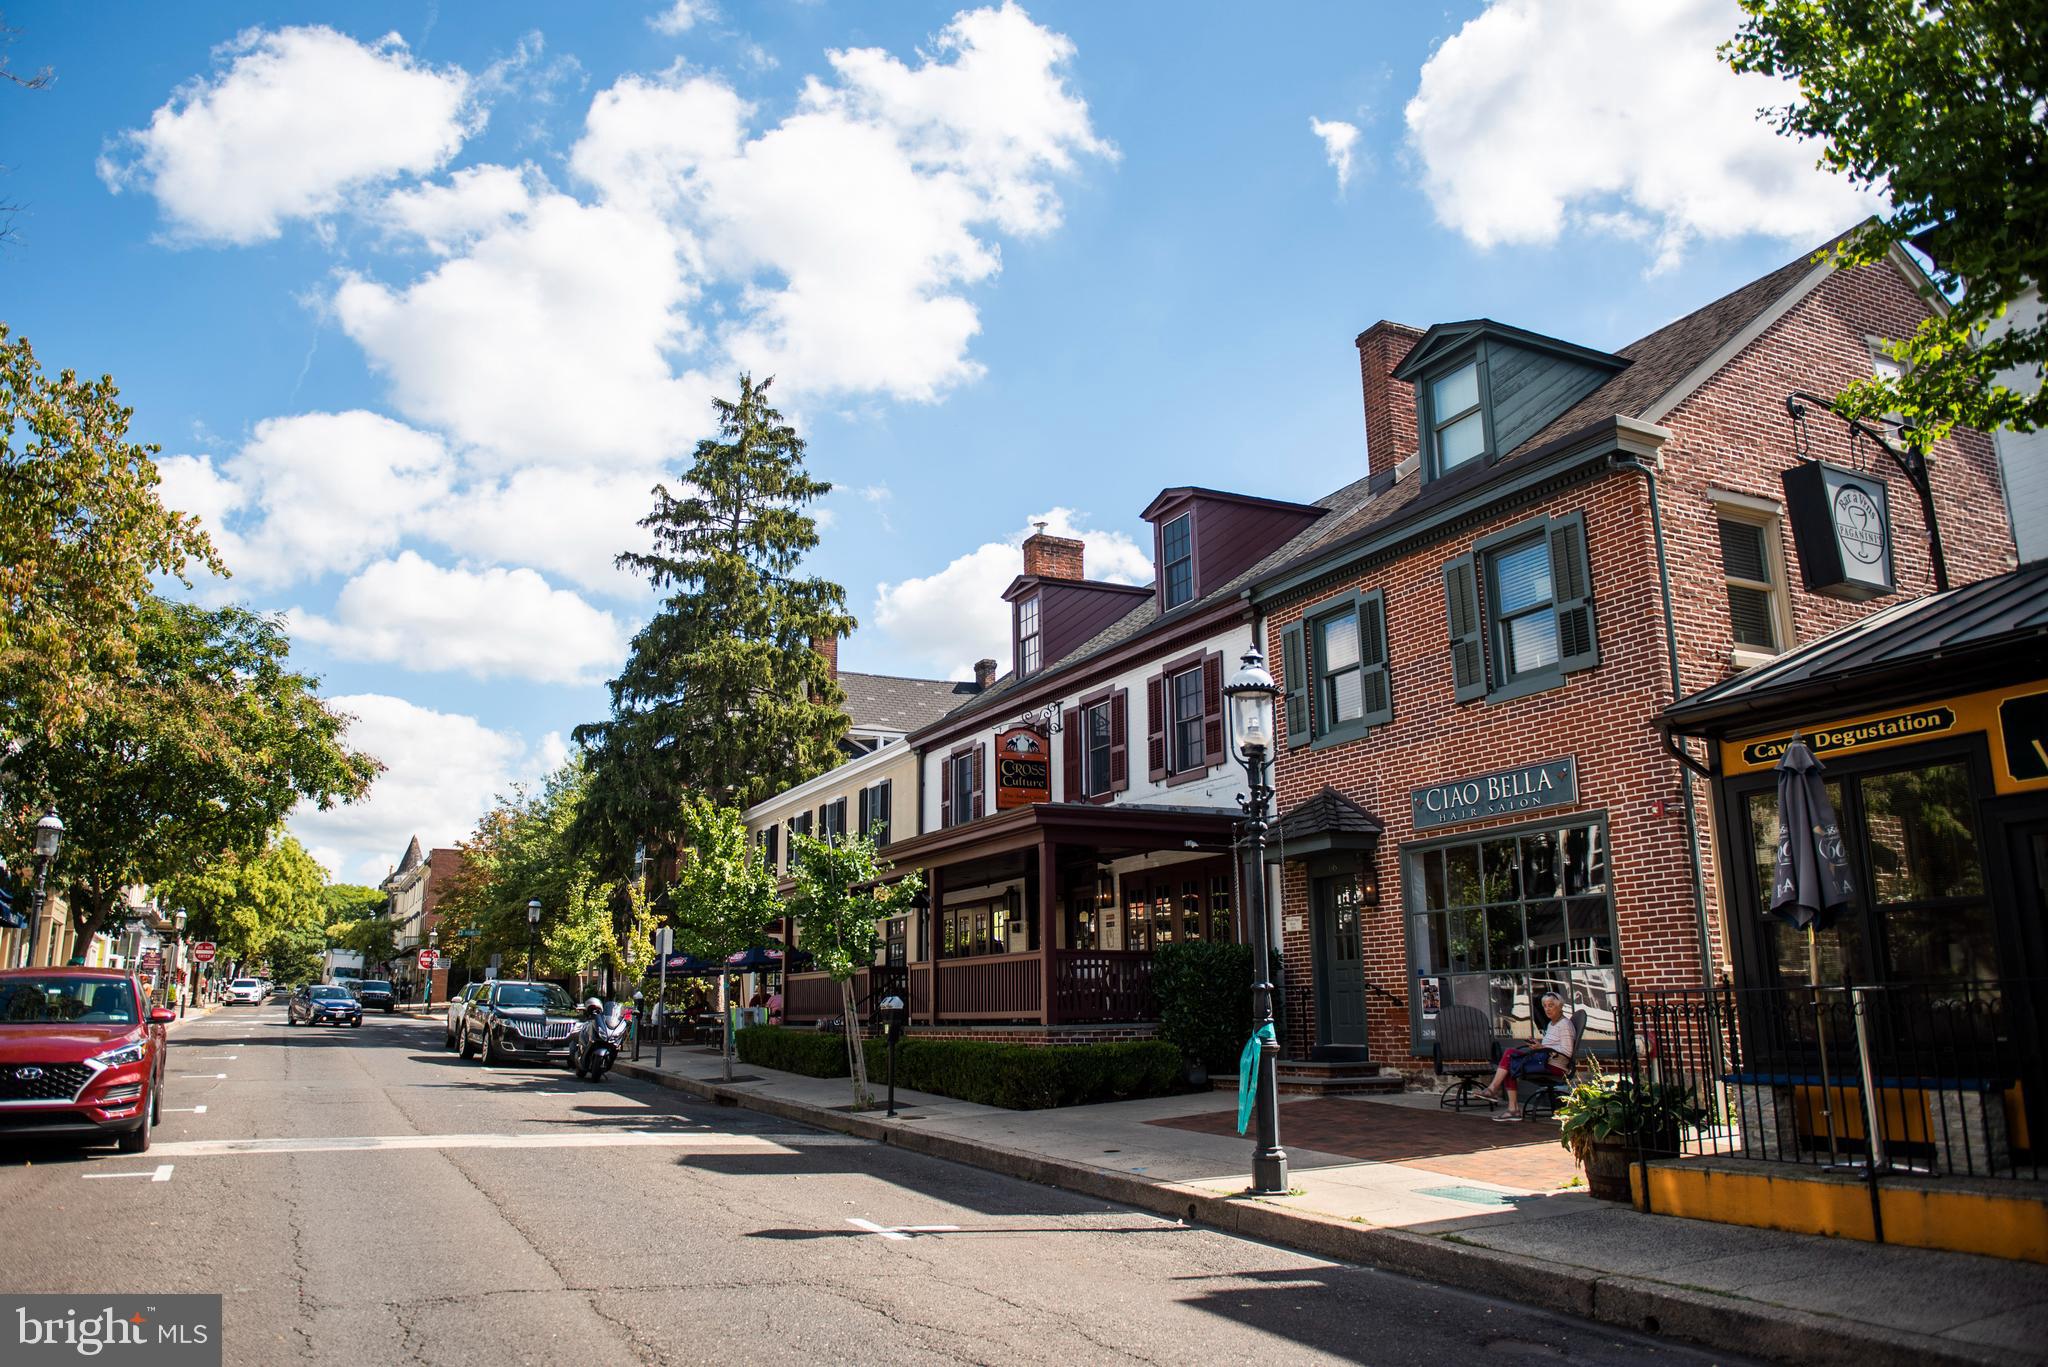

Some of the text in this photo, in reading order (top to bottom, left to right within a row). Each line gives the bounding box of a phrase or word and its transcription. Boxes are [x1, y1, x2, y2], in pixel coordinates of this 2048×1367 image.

[1838, 494, 1851, 511] Bar
[1754, 714, 1941, 758] Cav Degustation
[1003, 775, 1045, 787] Culture
[1426, 768, 1552, 812] CIAO BELLA
[1439, 796, 1543, 822] HAIR SALON
